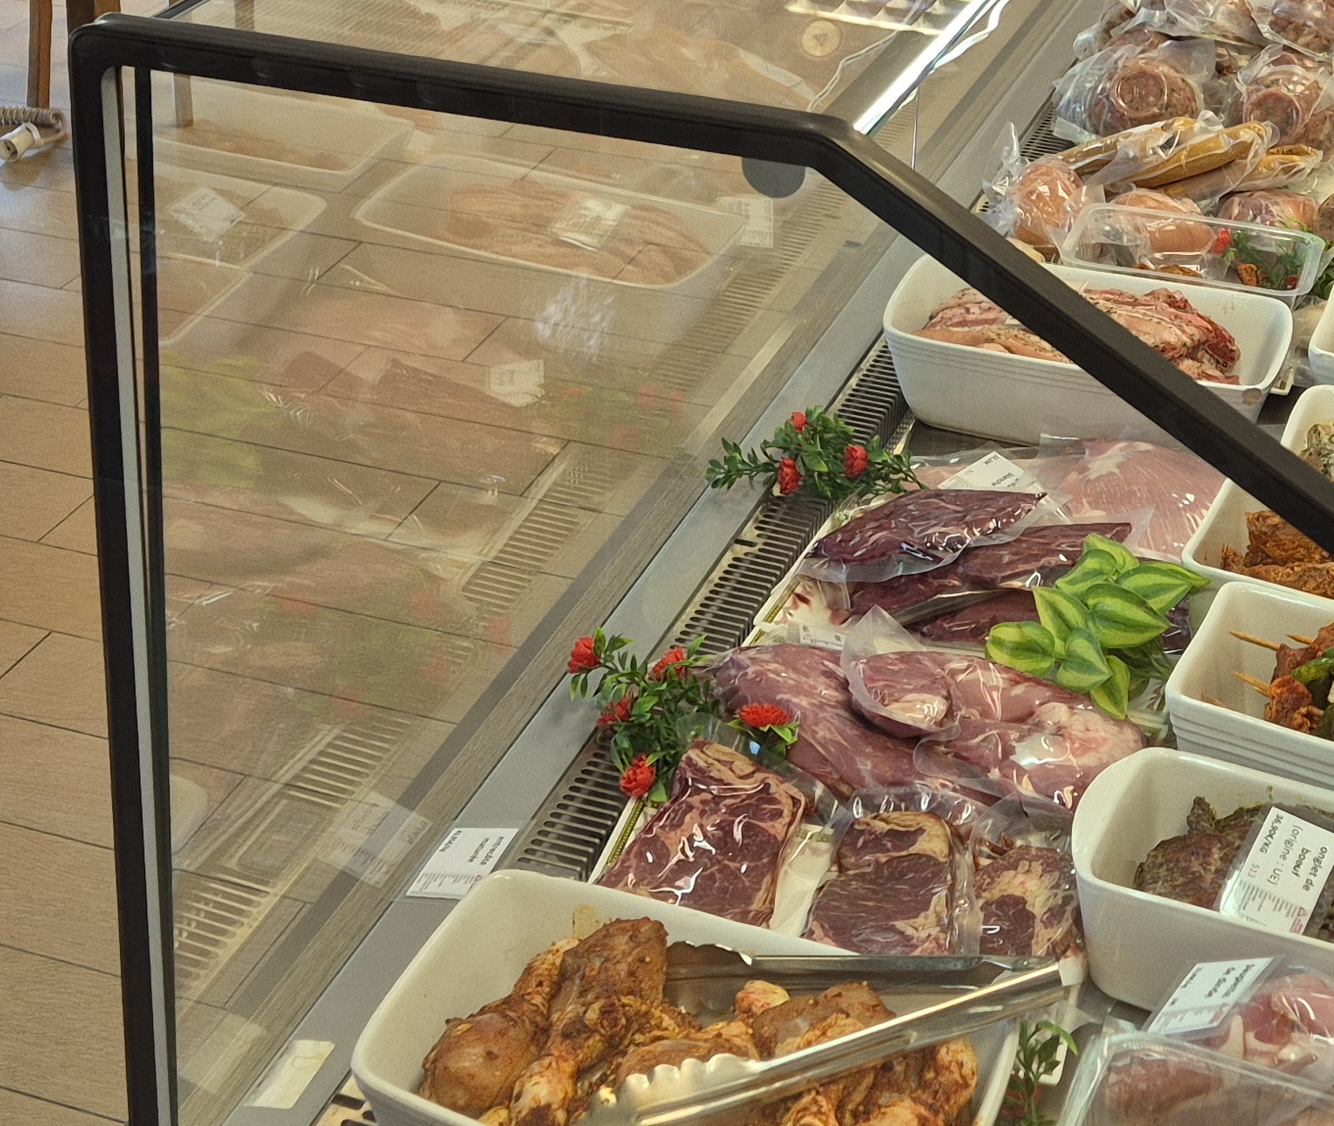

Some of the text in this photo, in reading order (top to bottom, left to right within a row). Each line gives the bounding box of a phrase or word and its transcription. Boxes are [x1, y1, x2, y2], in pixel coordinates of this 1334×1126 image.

[1279, 824, 1304, 862] (origine
[1266, 867, 1283, 886] UE)
[1291, 847, 1312, 878] boeuf
[1302, 846, 1328, 892] onglet de
